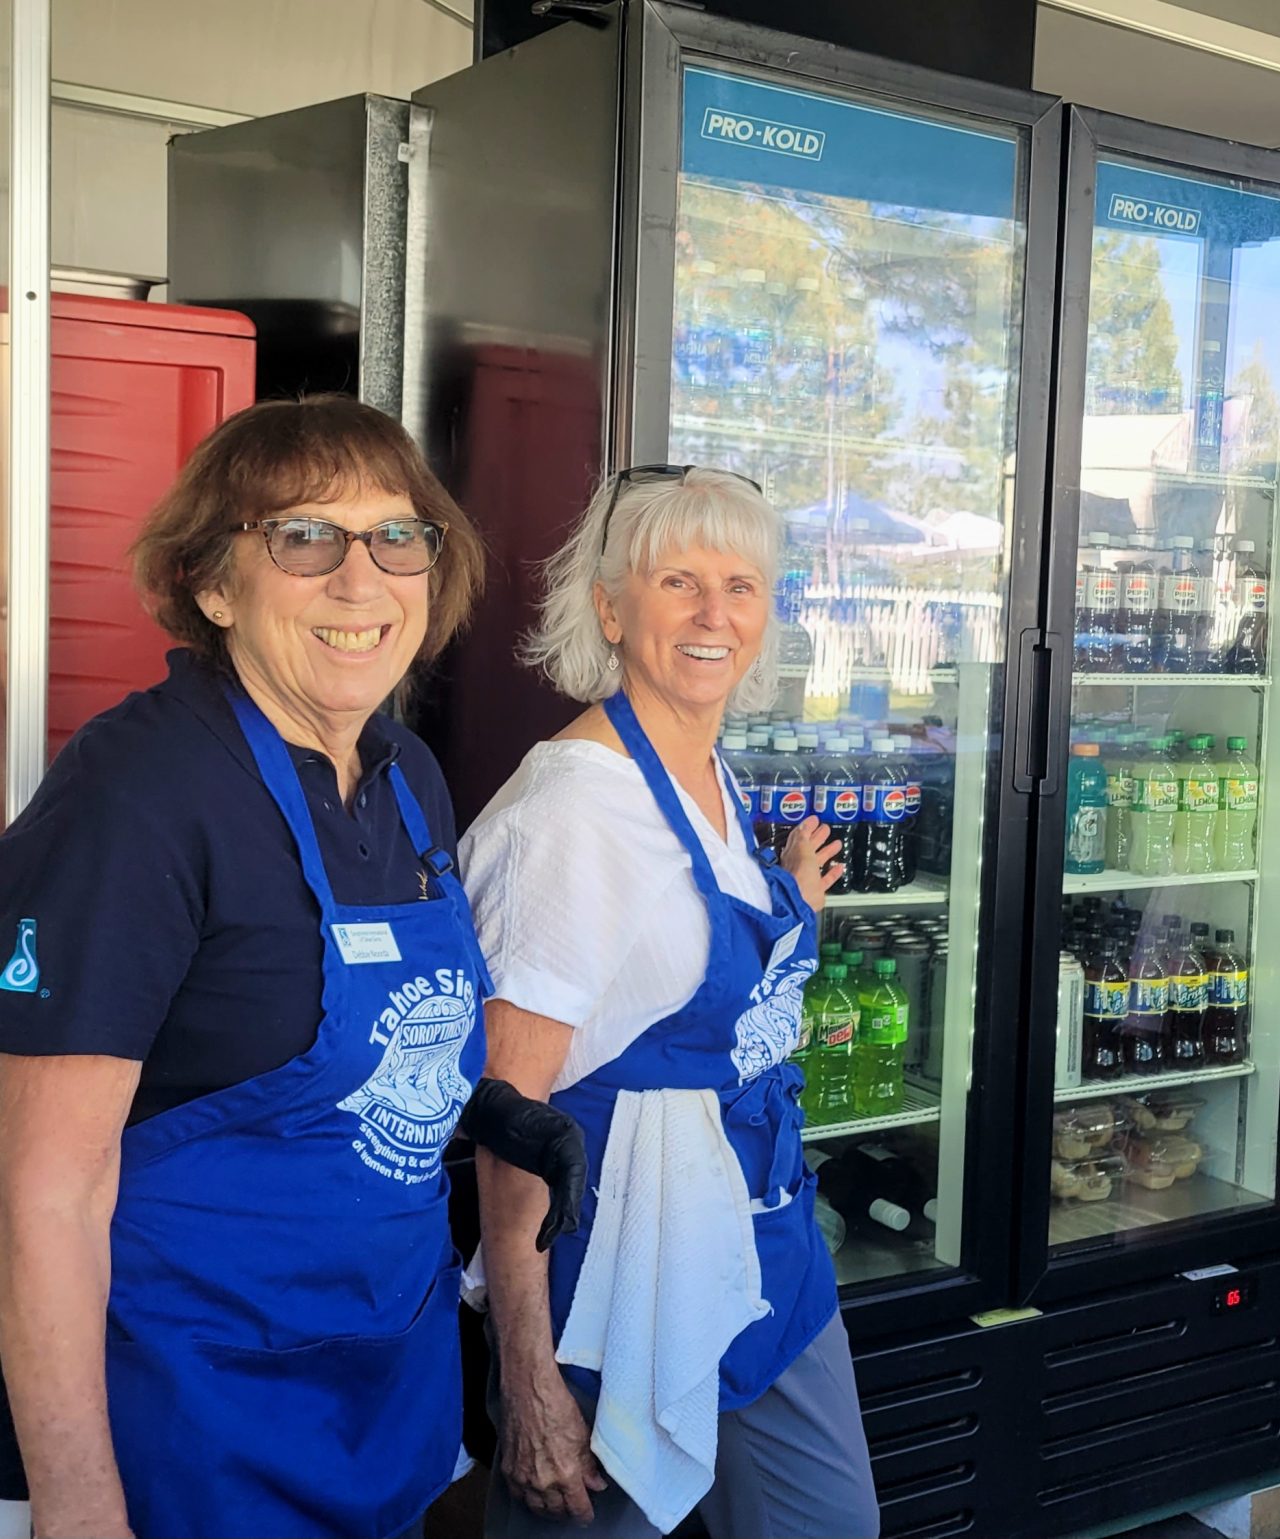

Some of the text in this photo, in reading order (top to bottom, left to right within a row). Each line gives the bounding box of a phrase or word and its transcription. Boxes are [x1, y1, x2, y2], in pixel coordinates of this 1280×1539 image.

[707, 113, 820, 155] PRO-KOLD
[1113, 198, 1197, 231] PRO-KOLD
[1126, 589, 1150, 598] PEPSI
[369, 976, 434, 1046] Tahoe
[359, 1122, 407, 1167] Strengthing
[408, 1156, 417, 1168] &
[360, 1150, 392, 1178] women
[393, 1168, 404, 1181] &
